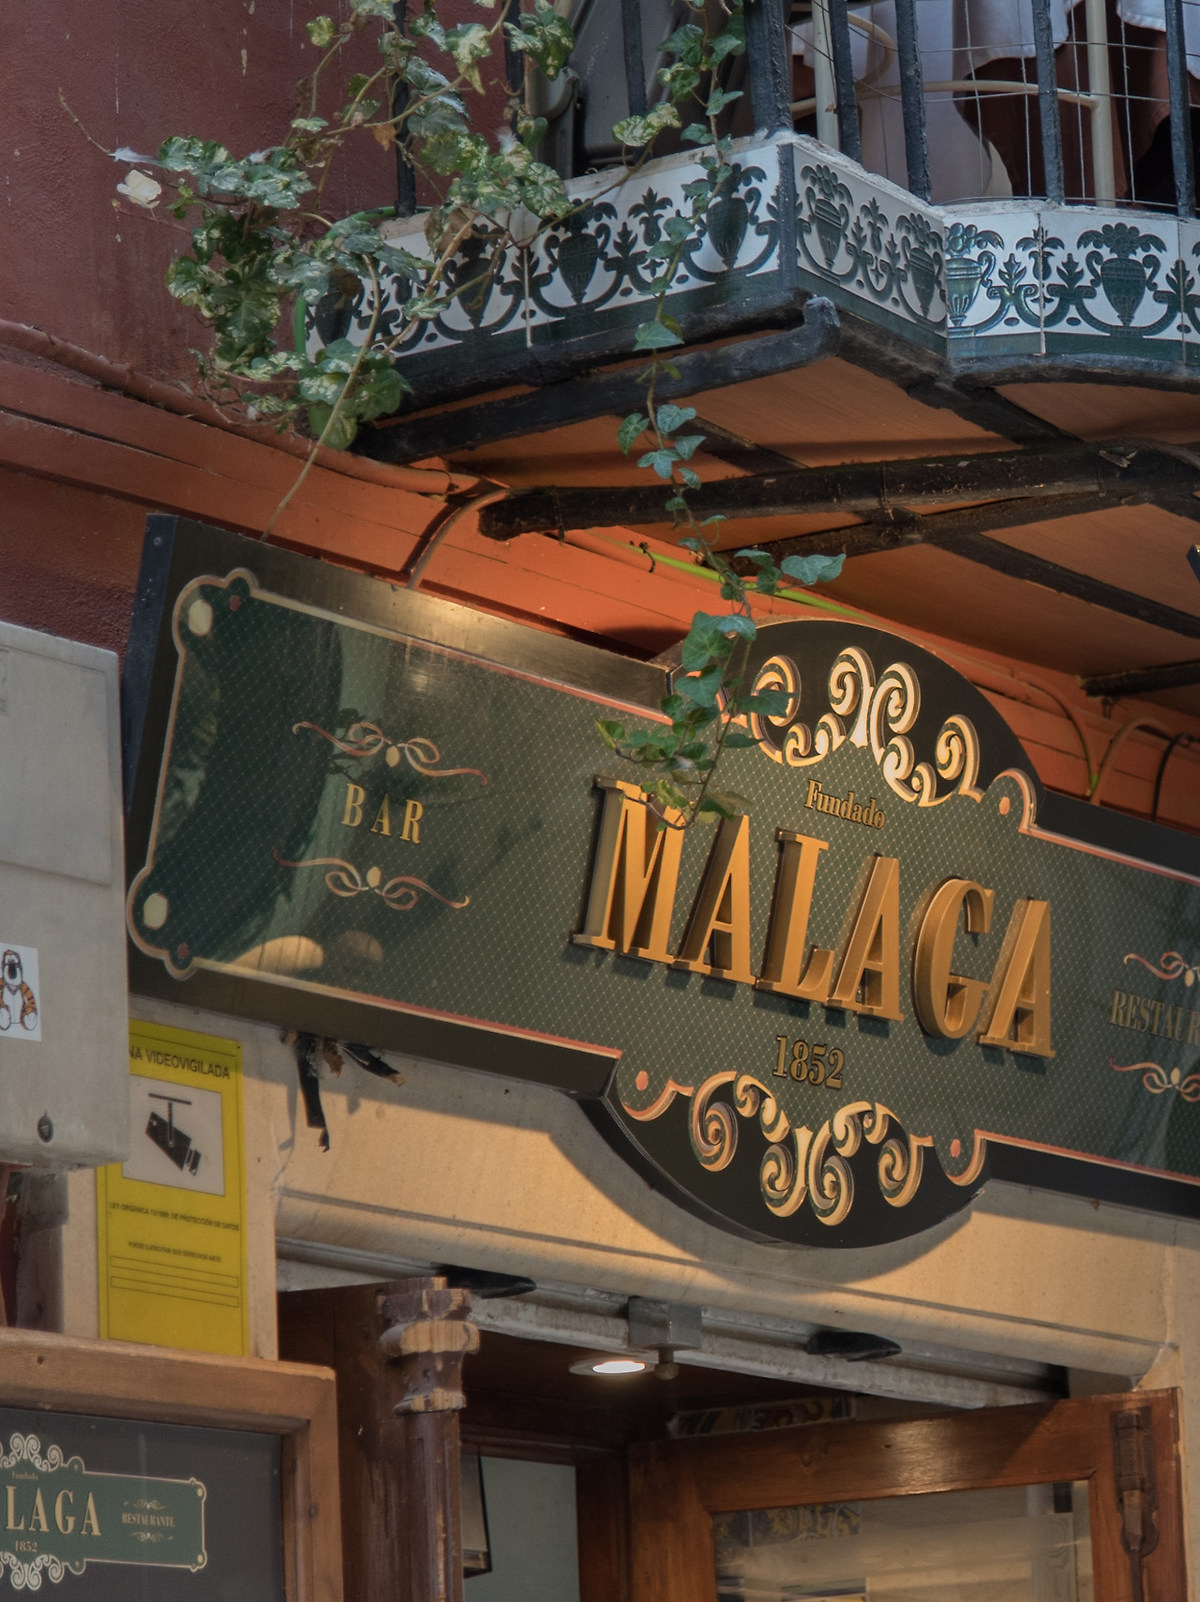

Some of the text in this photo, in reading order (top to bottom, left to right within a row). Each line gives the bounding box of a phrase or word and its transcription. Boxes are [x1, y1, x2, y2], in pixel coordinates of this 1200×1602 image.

[341, 783, 424, 844] BAR
[805, 779, 886, 830] Fundado
[569, 775, 1056, 1057] MALAGA
[145, 1050, 230, 1079] VIDEOVIGILADA
[773, 1035, 845, 1089] 1852
[121, 1513, 176, 1527] RESTAURANTE
[15, 1540, 38, 1553] 1852
